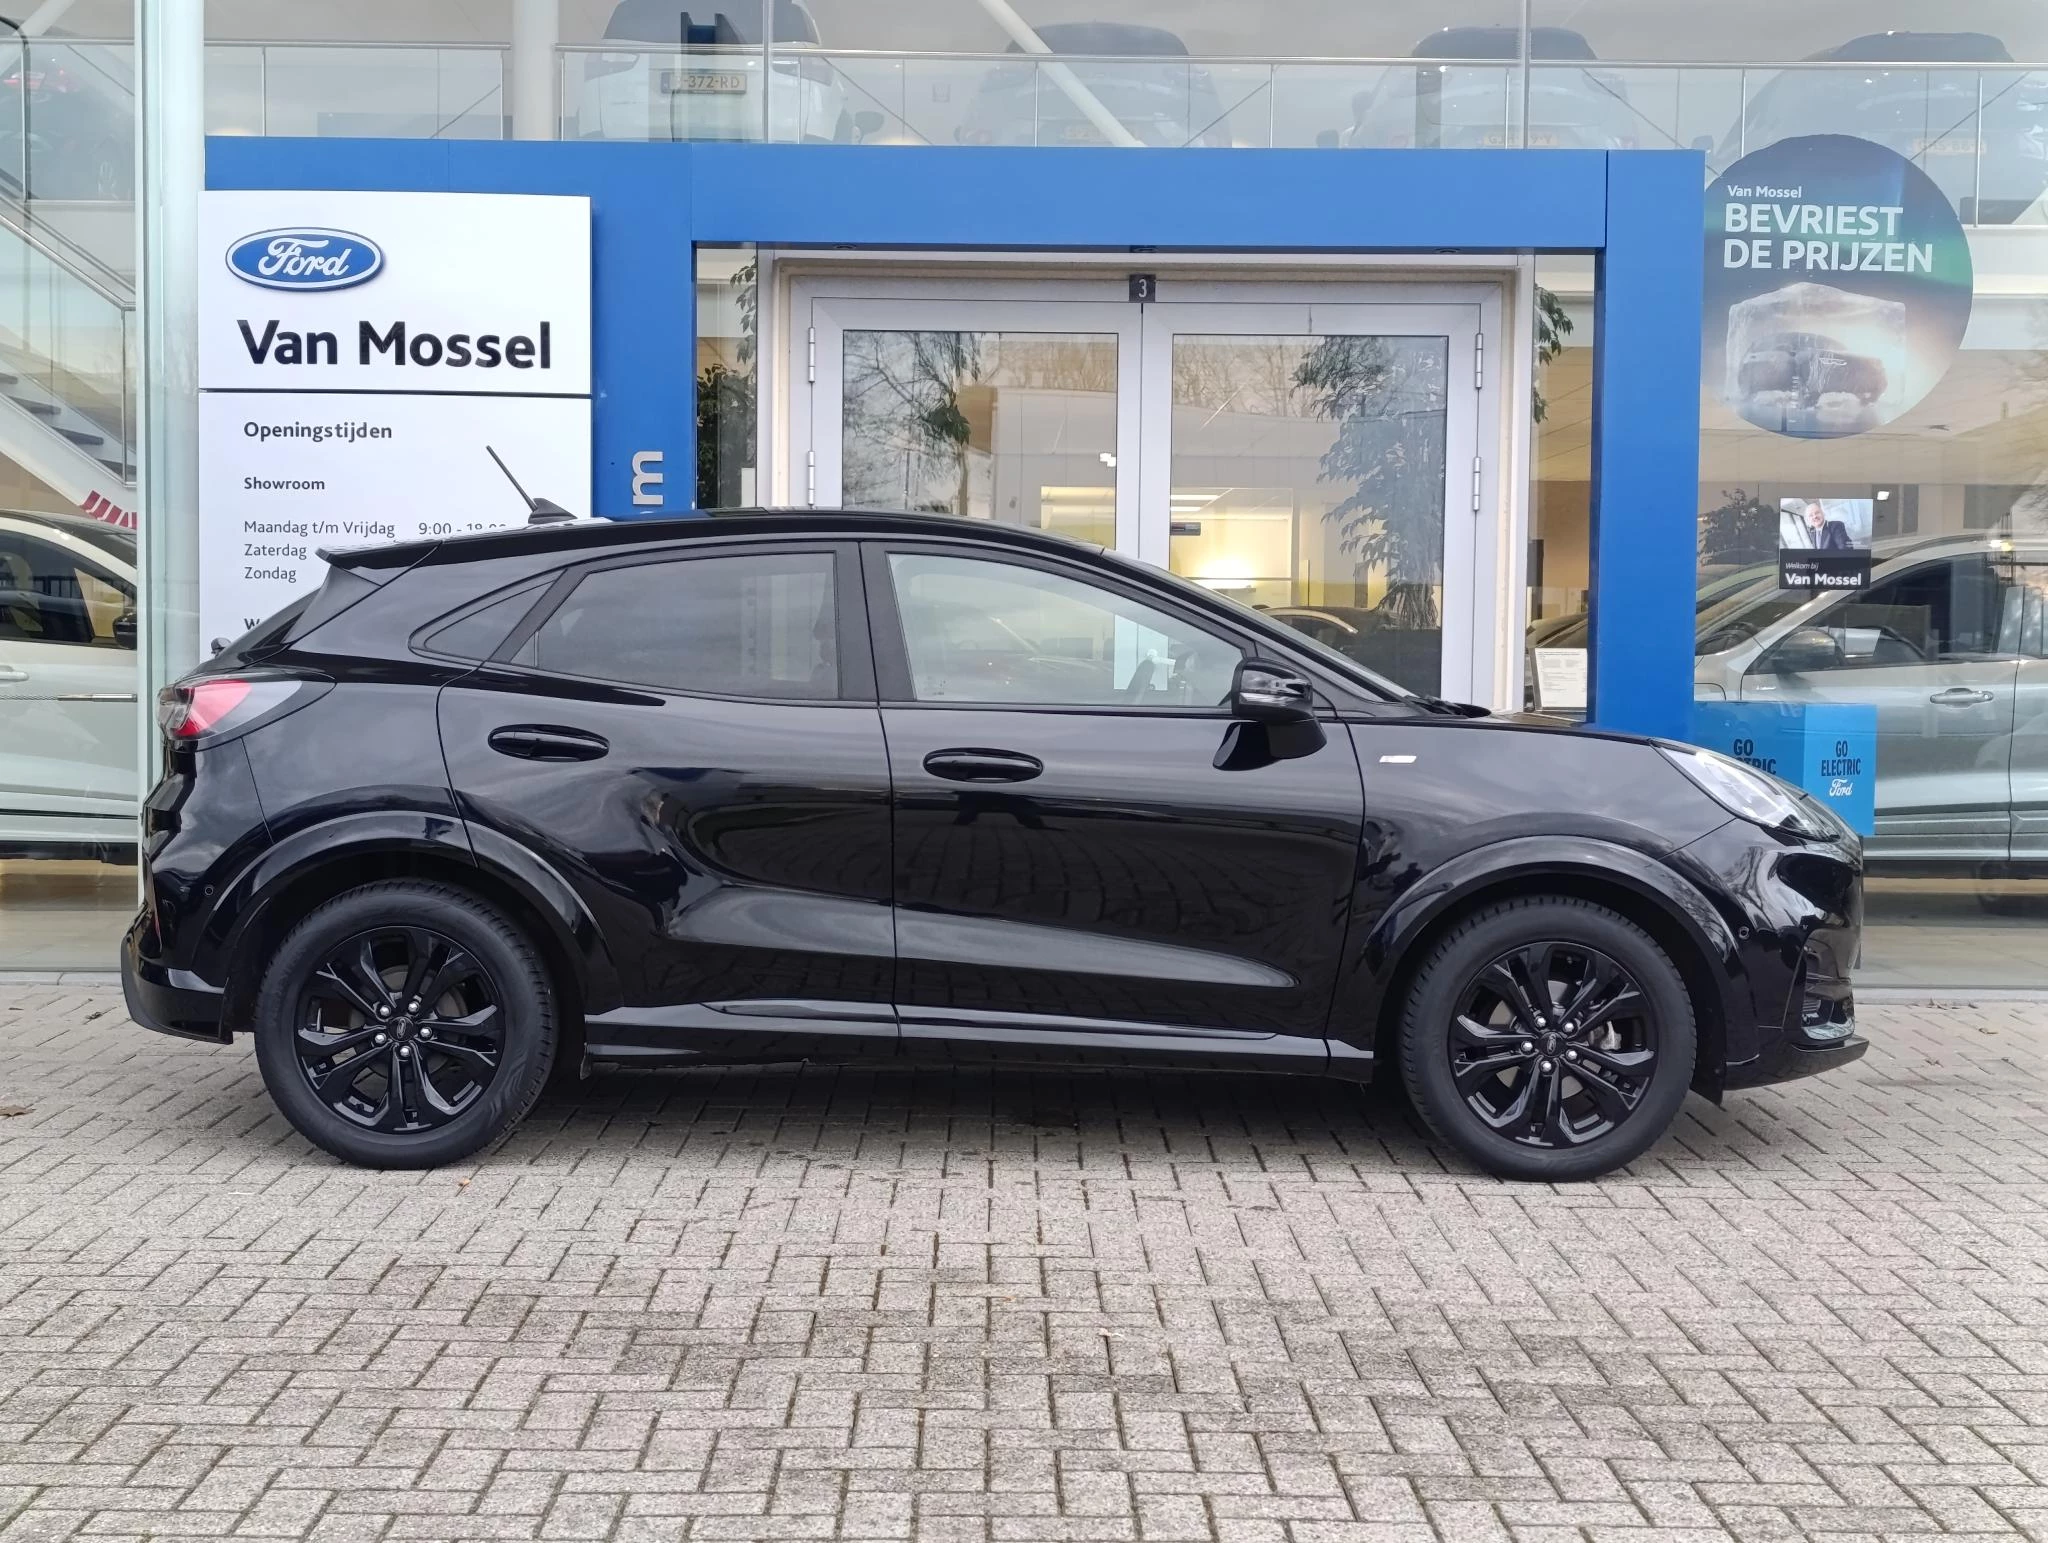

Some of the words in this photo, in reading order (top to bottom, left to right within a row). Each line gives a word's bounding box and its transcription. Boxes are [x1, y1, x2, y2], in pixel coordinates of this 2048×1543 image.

[1727, 185, 1751, 197] Van
[1755, 185, 1802, 199] Mossel
[1725, 203, 1904, 236] BEVRIEST
[257, 237, 352, 276] Ford
[1723, 238, 1773, 269] DE
[1782, 240, 1933, 273] PRIJZEN
[1138, 278, 1148, 298] 3
[236, 319, 338, 365] Van
[358, 320, 551, 369] Mossel
[243, 421, 393, 443] Openingstijden
[243, 476, 326, 490] Showroom
[243, 520, 308, 537] Maandag
[312, 521, 339, 534] t/m
[343, 521, 396, 538] Vrijdag
[418, 522, 452, 535] 9:00
[244, 544, 308, 560] Zaterdag
[244, 567, 297, 583] Zondag
[1785, 562, 1810, 570] Welkom
[1785, 573, 1811, 585] Van
[1814, 573, 1862, 586] Mossel
[1733, 738, 1754, 756] GO
[1835, 740, 1848, 758] GO
[1820, 758, 1862, 776] ELECTRIC
[1829, 778, 1854, 797] Ford
